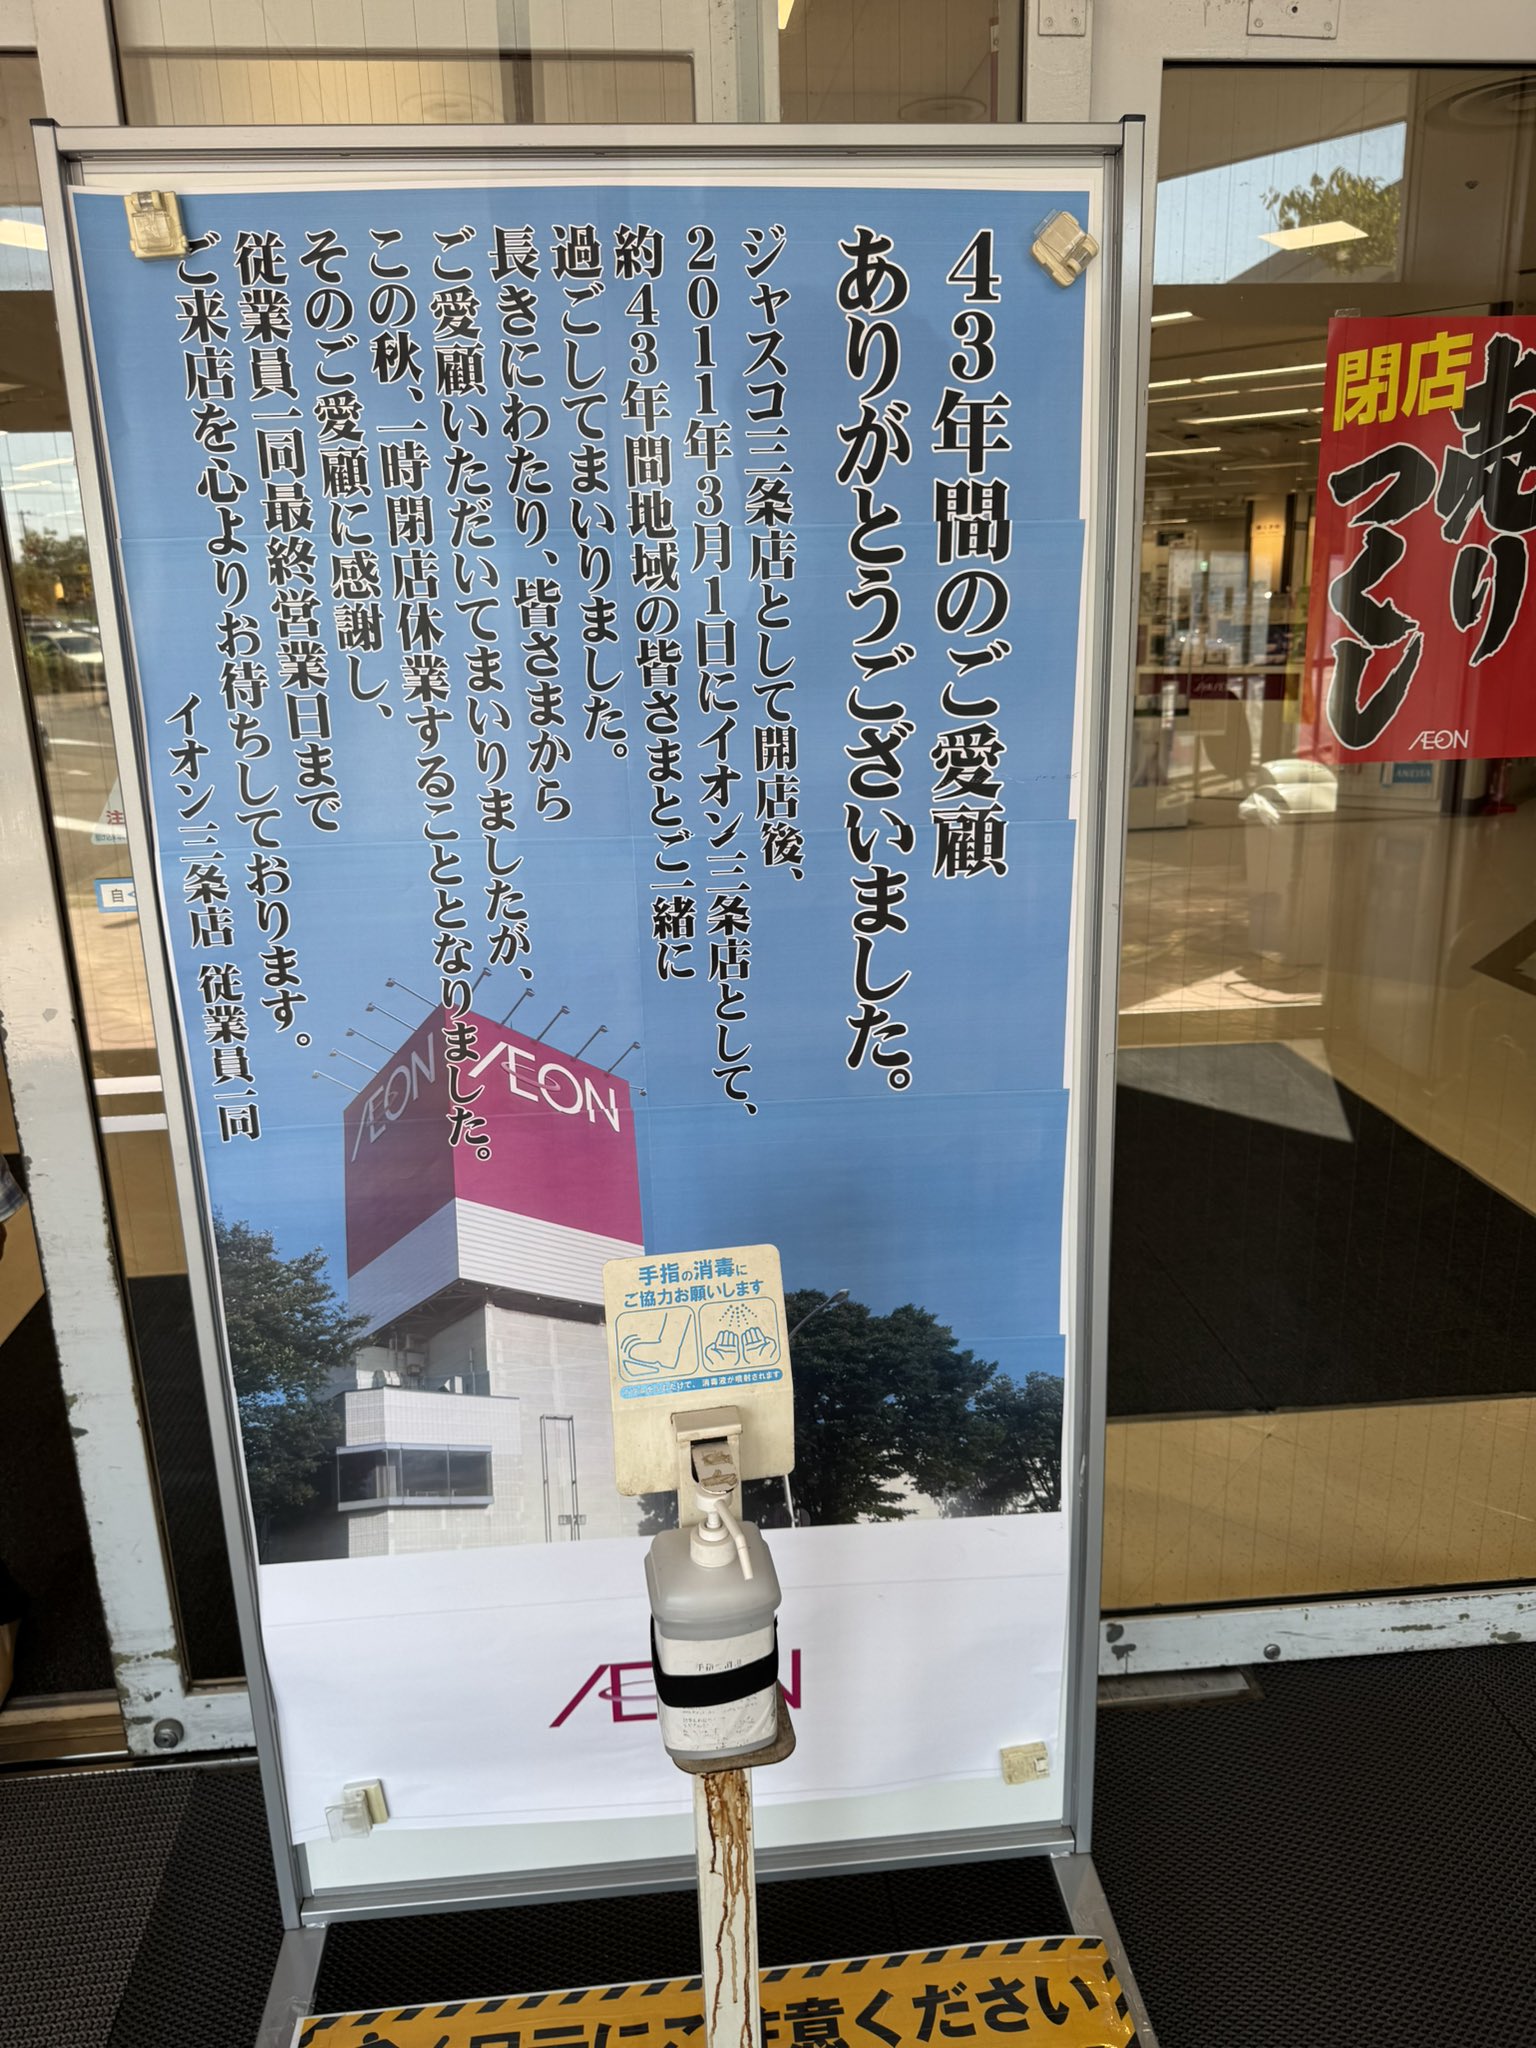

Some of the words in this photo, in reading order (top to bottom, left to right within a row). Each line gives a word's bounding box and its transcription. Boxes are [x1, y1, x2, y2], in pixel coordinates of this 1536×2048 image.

[175, 230, 312, 1050] ご来店を心よりお待ちしております。
[234, 230, 341, 833] 従業員一同最終営業日まで
[300, 228, 393, 719] そのご愛顧に感謝し、
[430, 226, 535, 981] ご愛顧いただいてまいりましたが、
[488, 224, 573, 821] 長きにわたり、皆さまから
[550, 224, 628, 762] 過ごしてまいりました。
[612, 223, 696, 981] 約43年間地域の皆さまとご一緒に
[684, 226, 758, 1116] 2011年3月1日にイオン三条店として、
[742, 223, 804, 881] ジャスコ三条店として開店後、
[836, 225, 916, 1092] ありがとうございました。
[931, 228, 1011, 879] 43年間のご愛顧
[1326, 442, 1439, 750] つくし
[1333, 331, 1474, 432] 閉店
[165, 692, 235, 950] イオン三条店
[367, 228, 493, 1163] この秋、一時閉店休業することとなりました。
[196, 963, 261, 1144] 従業員一同
[623, 1279, 764, 1309] ご協力お願いします
[638, 1257, 748, 1286] 手指の消毒に
